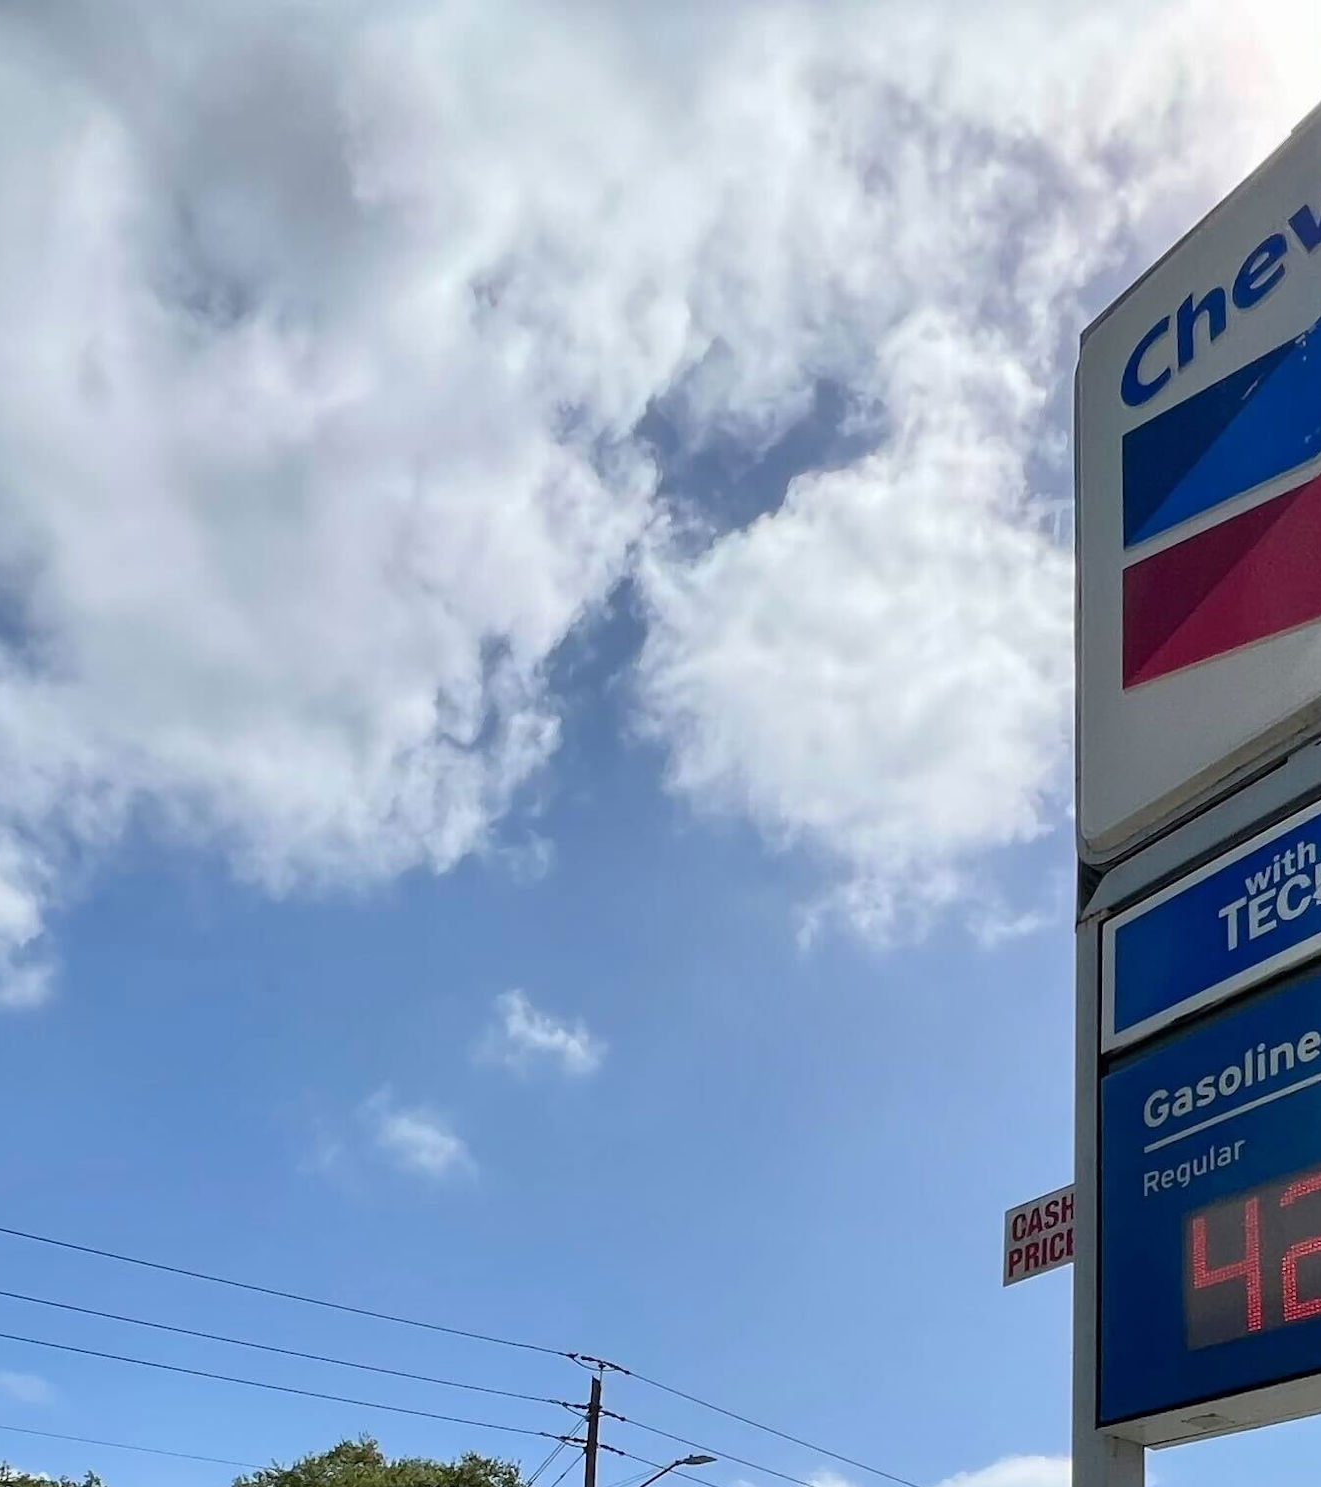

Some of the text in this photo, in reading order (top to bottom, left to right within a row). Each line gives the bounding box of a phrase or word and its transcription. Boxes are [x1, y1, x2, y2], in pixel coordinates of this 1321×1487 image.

[1244, 841, 1317, 896] with
[1143, 1139, 1246, 1197] Regular
[1012, 1193, 1074, 1242] CASH
